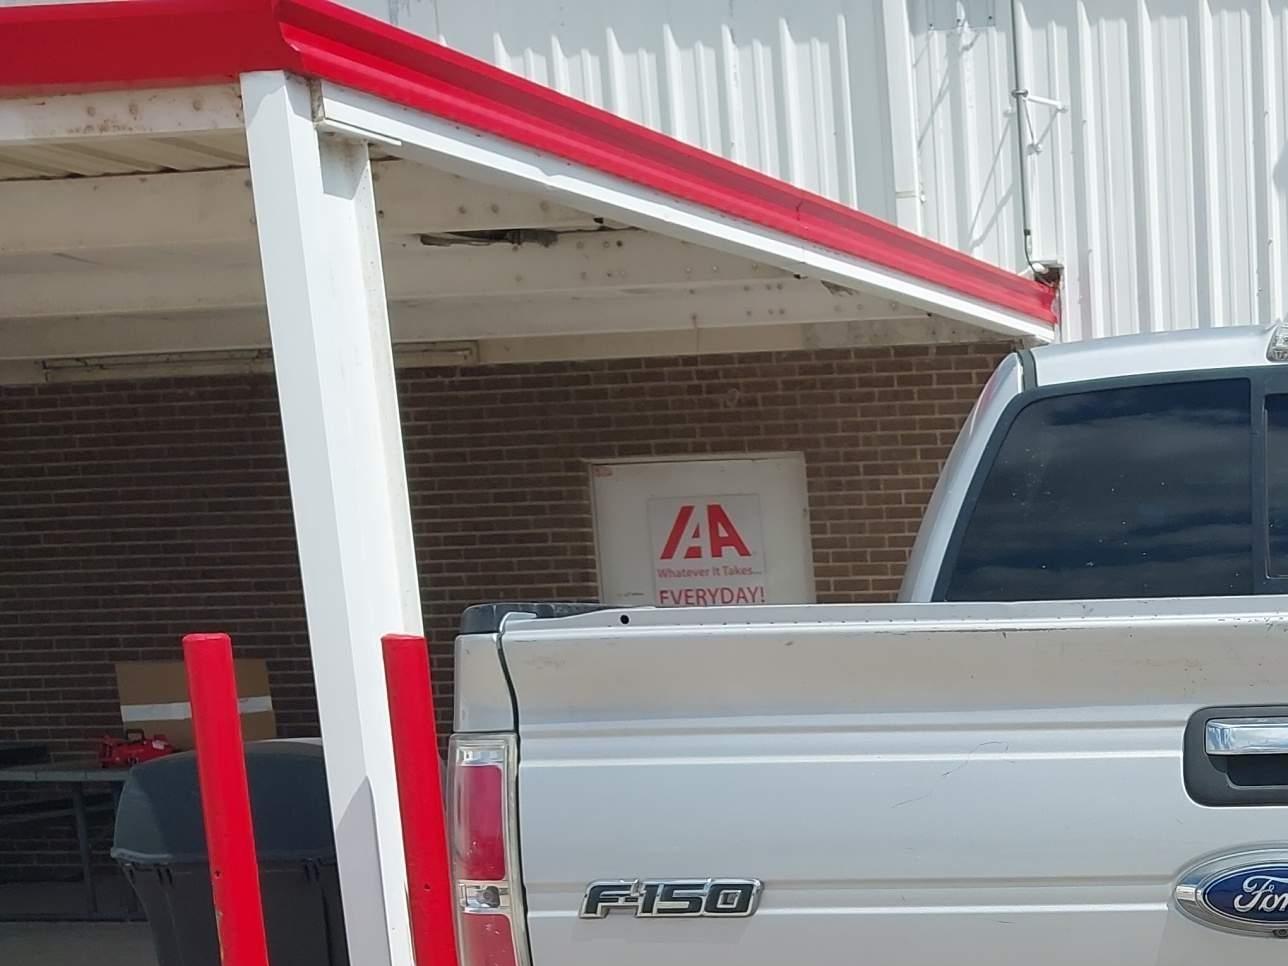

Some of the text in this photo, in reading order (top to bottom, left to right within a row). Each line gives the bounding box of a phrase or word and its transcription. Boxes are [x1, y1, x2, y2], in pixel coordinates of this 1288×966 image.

[657, 567, 710, 579] Whatever
[659, 586, 766, 605] EVERYDAY!
[580, 878, 762, 918] F-150
